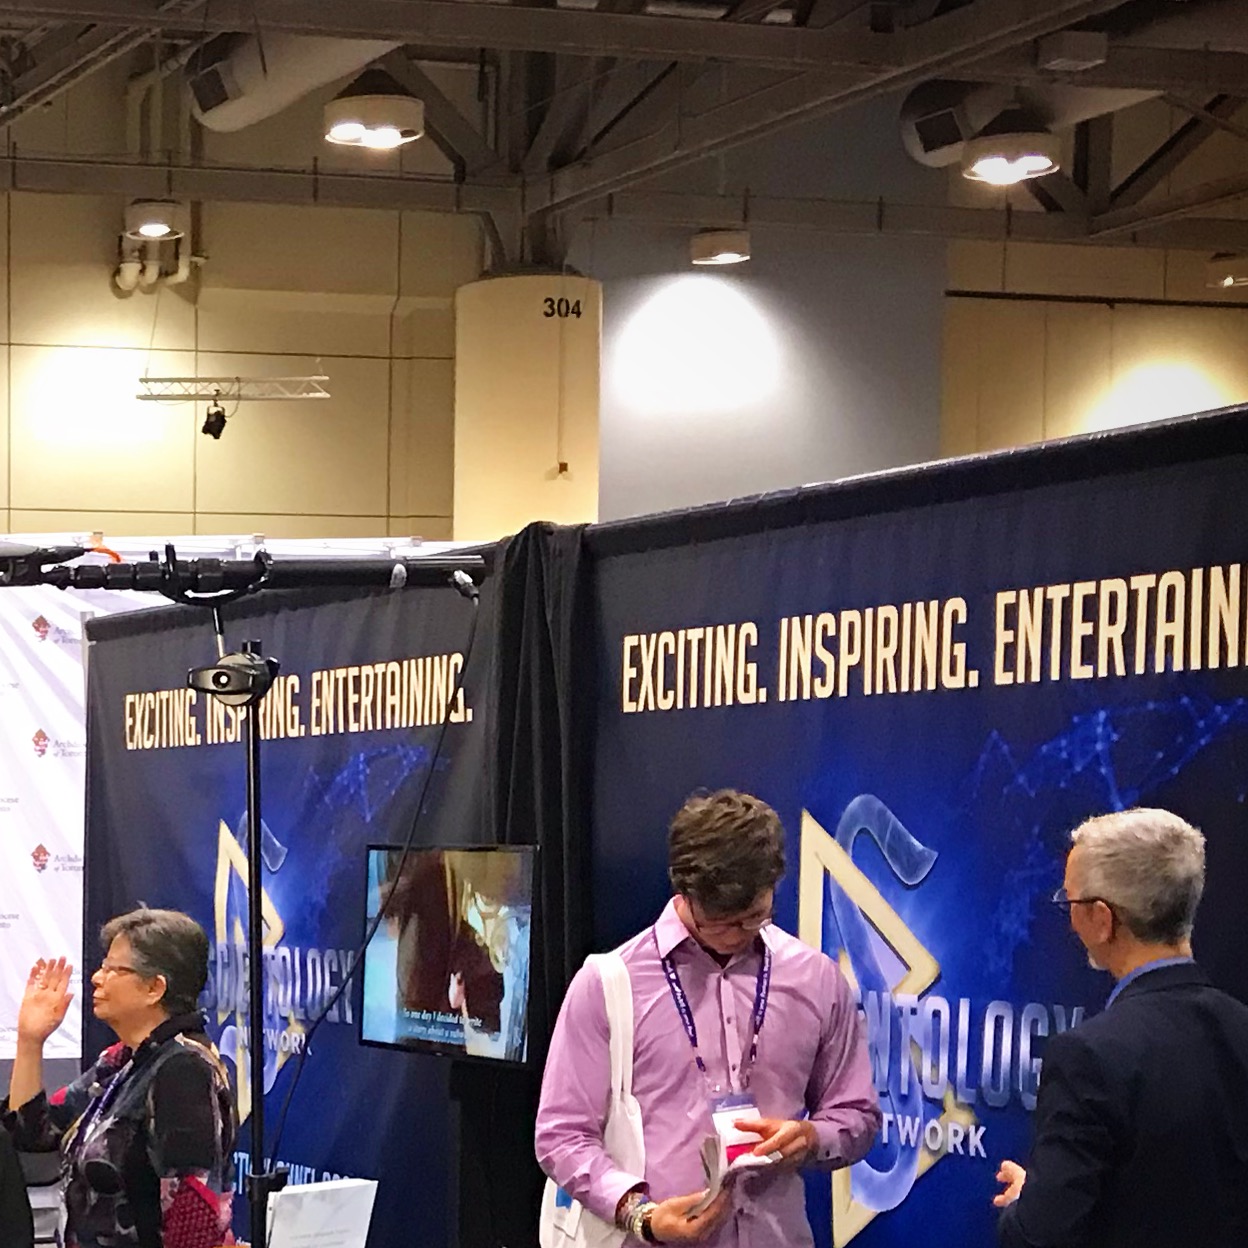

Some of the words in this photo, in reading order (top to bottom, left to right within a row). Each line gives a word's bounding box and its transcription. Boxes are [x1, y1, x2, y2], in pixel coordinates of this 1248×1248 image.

[543, 297, 582, 318] 304
[621, 622, 767, 713] EXCITING.
[778, 597, 979, 702] INSPIRING.
[994, 563, 1248, 686] ENTERTAIN
[124, 688, 201, 750] EXCITING.
[206, 674, 305, 744] INSPRING.
[311, 653, 473, 737] ENTERTAINING.
[882, 1113, 988, 1159] TWORK
